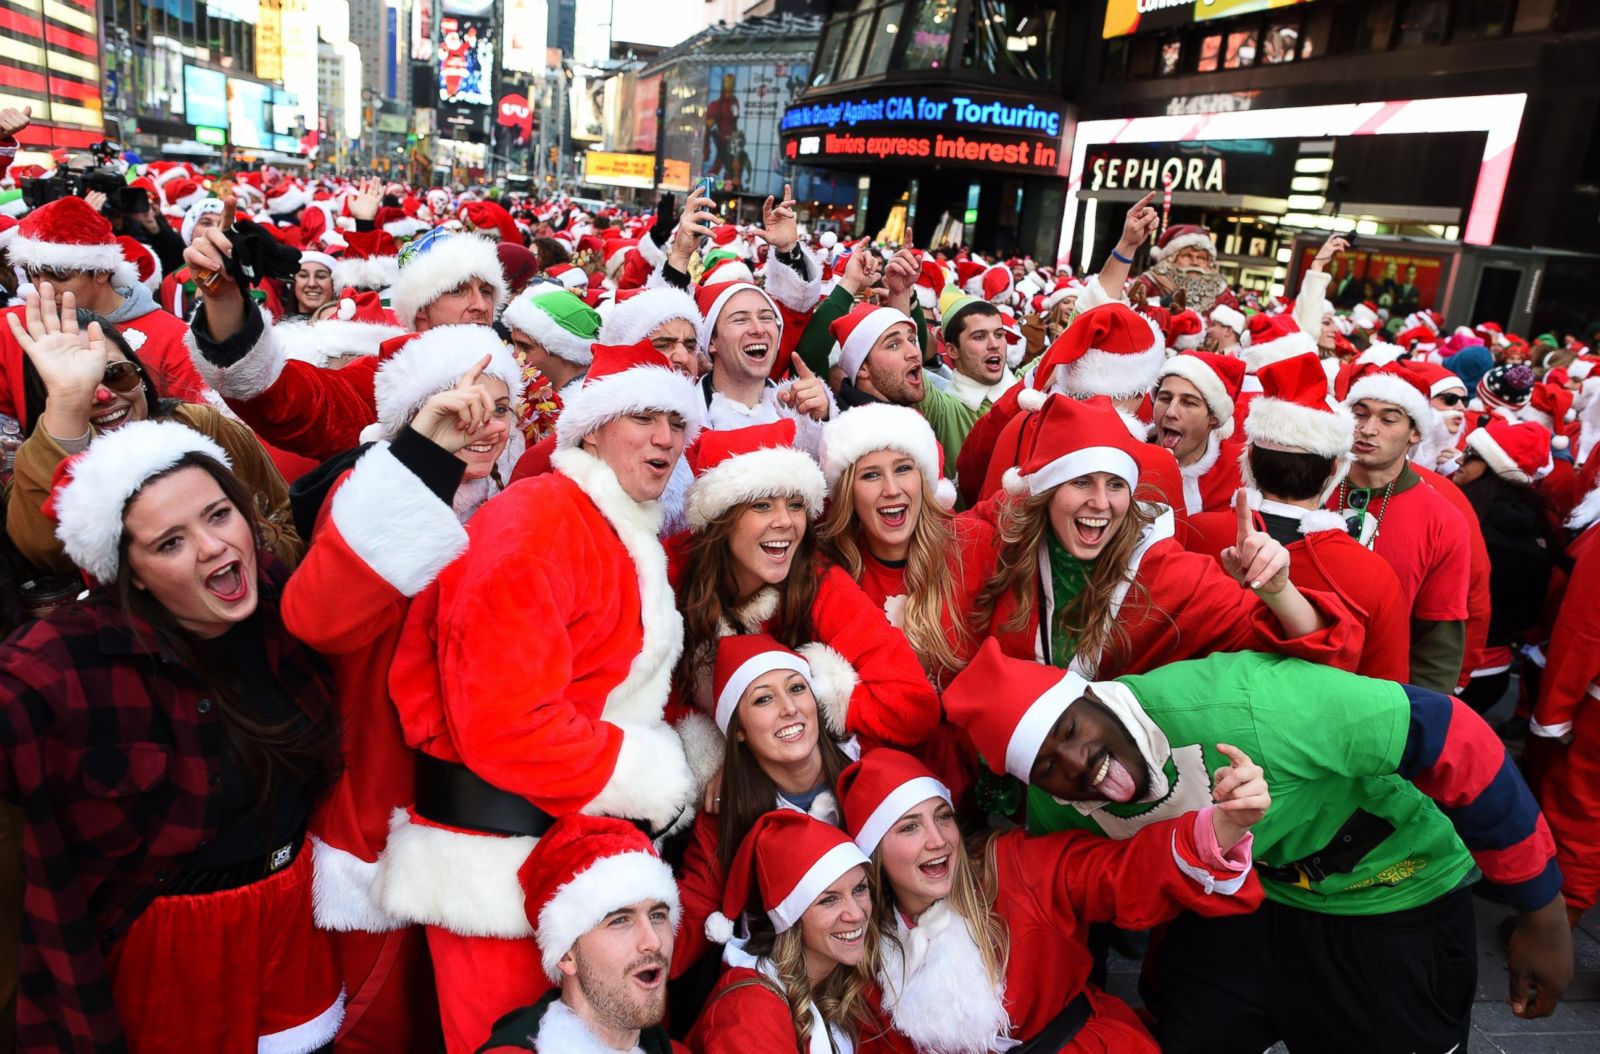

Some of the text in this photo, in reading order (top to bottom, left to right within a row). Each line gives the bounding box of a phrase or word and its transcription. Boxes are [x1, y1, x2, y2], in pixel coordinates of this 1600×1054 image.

[843, 99, 884, 126] Against
[886, 97, 914, 120] CIA
[918, 97, 948, 120] for
[952, 97, 1060, 136] Torturing
[825, 133, 865, 154] Warriors
[867, 137, 930, 159] express
[935, 134, 1029, 165] interest
[1034, 142, 1057, 167] in
[1091, 157, 1223, 191] SEPHORA
